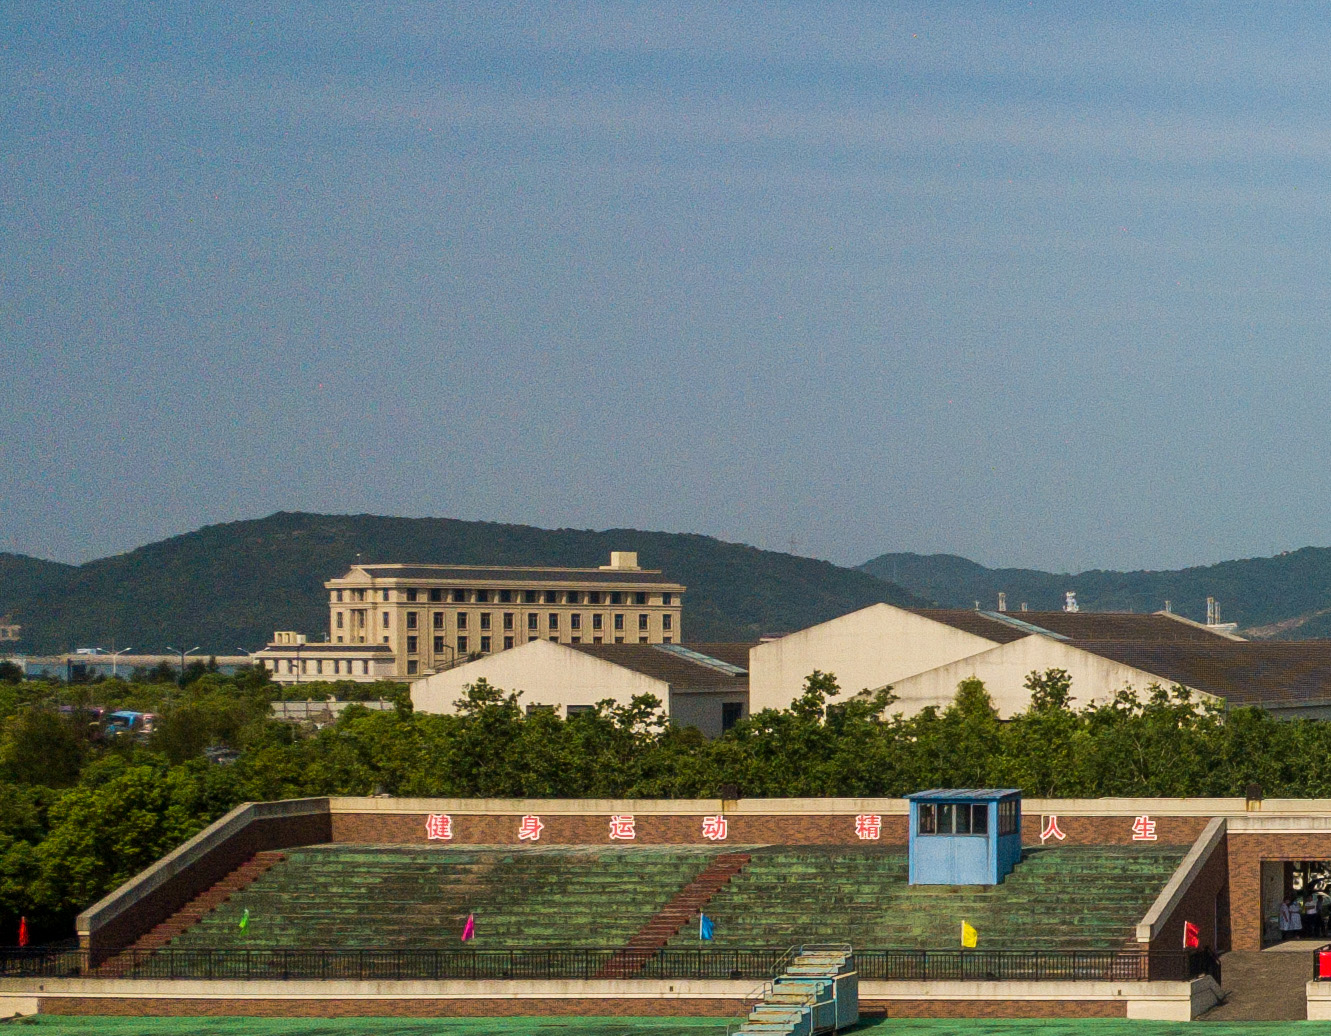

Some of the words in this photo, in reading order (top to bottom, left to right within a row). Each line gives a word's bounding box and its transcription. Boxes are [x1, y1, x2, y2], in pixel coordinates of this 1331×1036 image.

[426, 814, 728, 840] 健身运动
[855, 815, 1158, 840] 精人生
